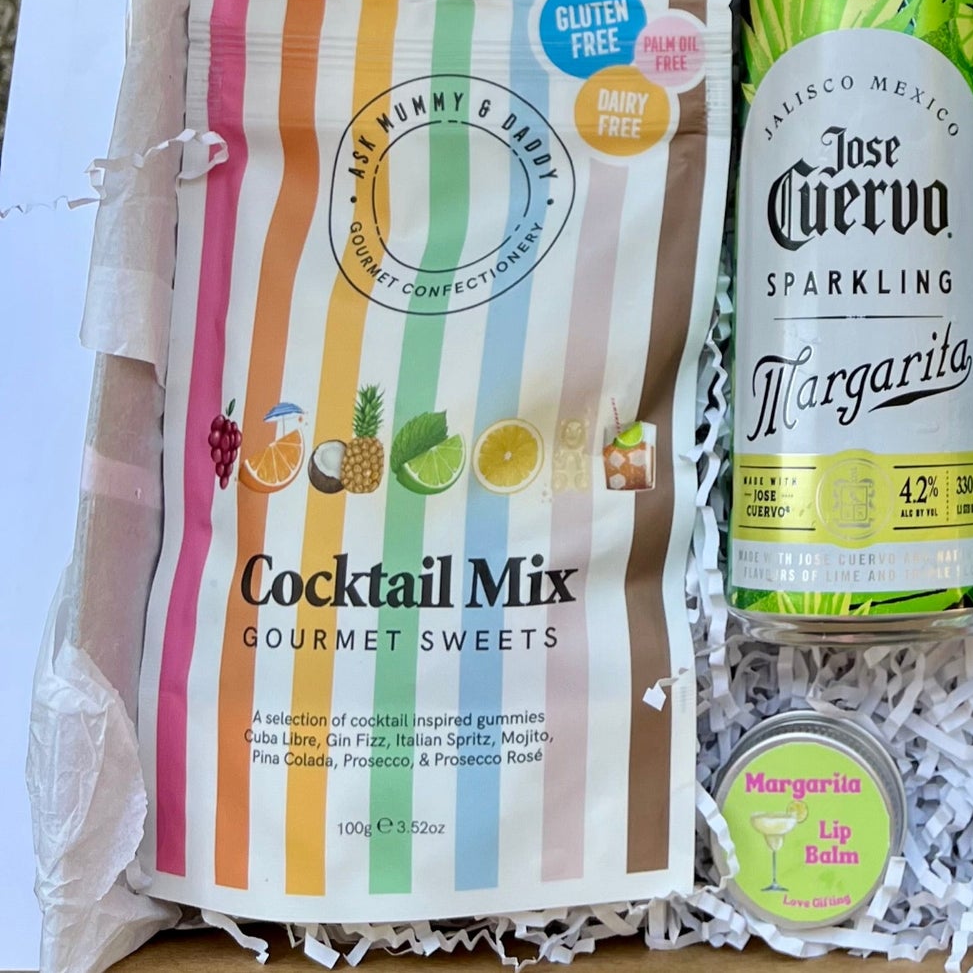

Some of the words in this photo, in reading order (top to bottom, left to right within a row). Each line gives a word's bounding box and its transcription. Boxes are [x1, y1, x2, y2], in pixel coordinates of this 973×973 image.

[571, 28, 621, 59] FREE
[643, 36, 676, 53] PALM
[679, 35, 700, 52] OIL
[655, 55, 688, 72] FREE
[597, 88, 650, 113] DAIRY
[765, 75, 854, 141] JALISCO
[869, 75, 960, 137] MEXICO
[347, 134, 377, 180] ASK
[375, 91, 465, 135] MUMMY
[478, 98, 492, 118] &
[500, 113, 559, 182] DADDY
[597, 113, 641, 139] FREE
[820, 126, 901, 179] Jose
[767, 158, 949, 252] Cuervo
[349, 221, 400, 290] GOURMET
[401, 221, 545, 299] CONFECTIONERY
[767, 269, 952, 297] SPARKLING
[747, 321, 973, 442] Margarita
[753, 490, 777, 502] JOSE
[899, 475, 939, 504] 4.2%
[956, 475, 973, 494] 330
[900, 508, 913, 518] ALC
[838, 553, 895, 565] CUERVO
[240, 553, 455, 609] Cocktail
[465, 553, 579, 609] Mix
[825, 570, 862, 582] LIME
[243, 626, 401, 651] GOURMET
[420, 626, 559, 651] SWEETS
[252, 710, 263, 725] A
[265, 711, 328, 727] selection
[331, 712, 347, 728] of
[350, 712, 410, 728] cocktail
[412, 712, 473, 730] inspired
[476, 710, 546, 730] gummies
[244, 729, 279, 746] Cuba
[282, 731, 322, 750] Libre,
[326, 733, 351, 748] Gin
[355, 733, 392, 750] Fizz,
[395, 733, 442, 748] Italian
[446, 732, 497, 751] Spritz,
[500, 729, 555, 749] Mojito,
[252, 750, 280, 766] Pina
[283, 751, 339, 771] Colada,
[343, 753, 415, 771] Prosecco,
[418, 753, 431, 768] &
[434, 752, 502, 768] Prosecco
[506, 748, 543, 764] Rosé
[745, 772, 862, 800] Margarita
[336, 821, 373, 837] 100g
[396, 820, 445, 835] 3.52oz
[819, 820, 852, 845] Lip
[805, 845, 859, 865] Balm
[783, 894, 810, 908] Love
